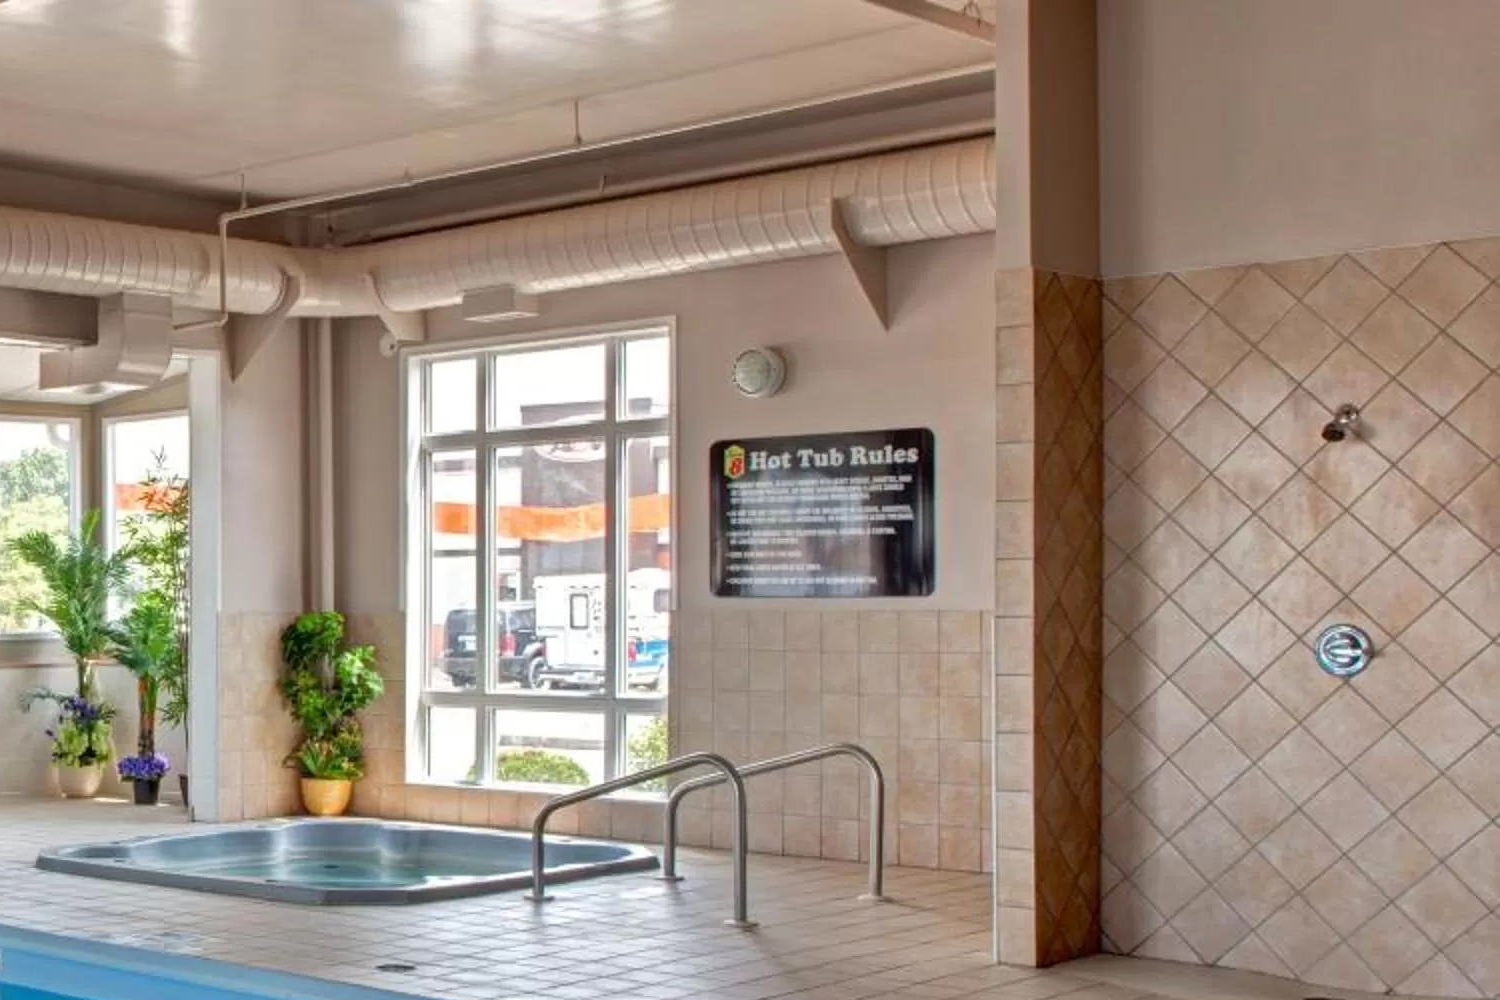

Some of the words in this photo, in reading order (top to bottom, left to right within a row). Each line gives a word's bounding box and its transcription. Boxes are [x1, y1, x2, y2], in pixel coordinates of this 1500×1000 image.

[749, 451, 792, 471] Hot
[796, 448, 844, 468] Tub
[850, 443, 919, 467] Rules
